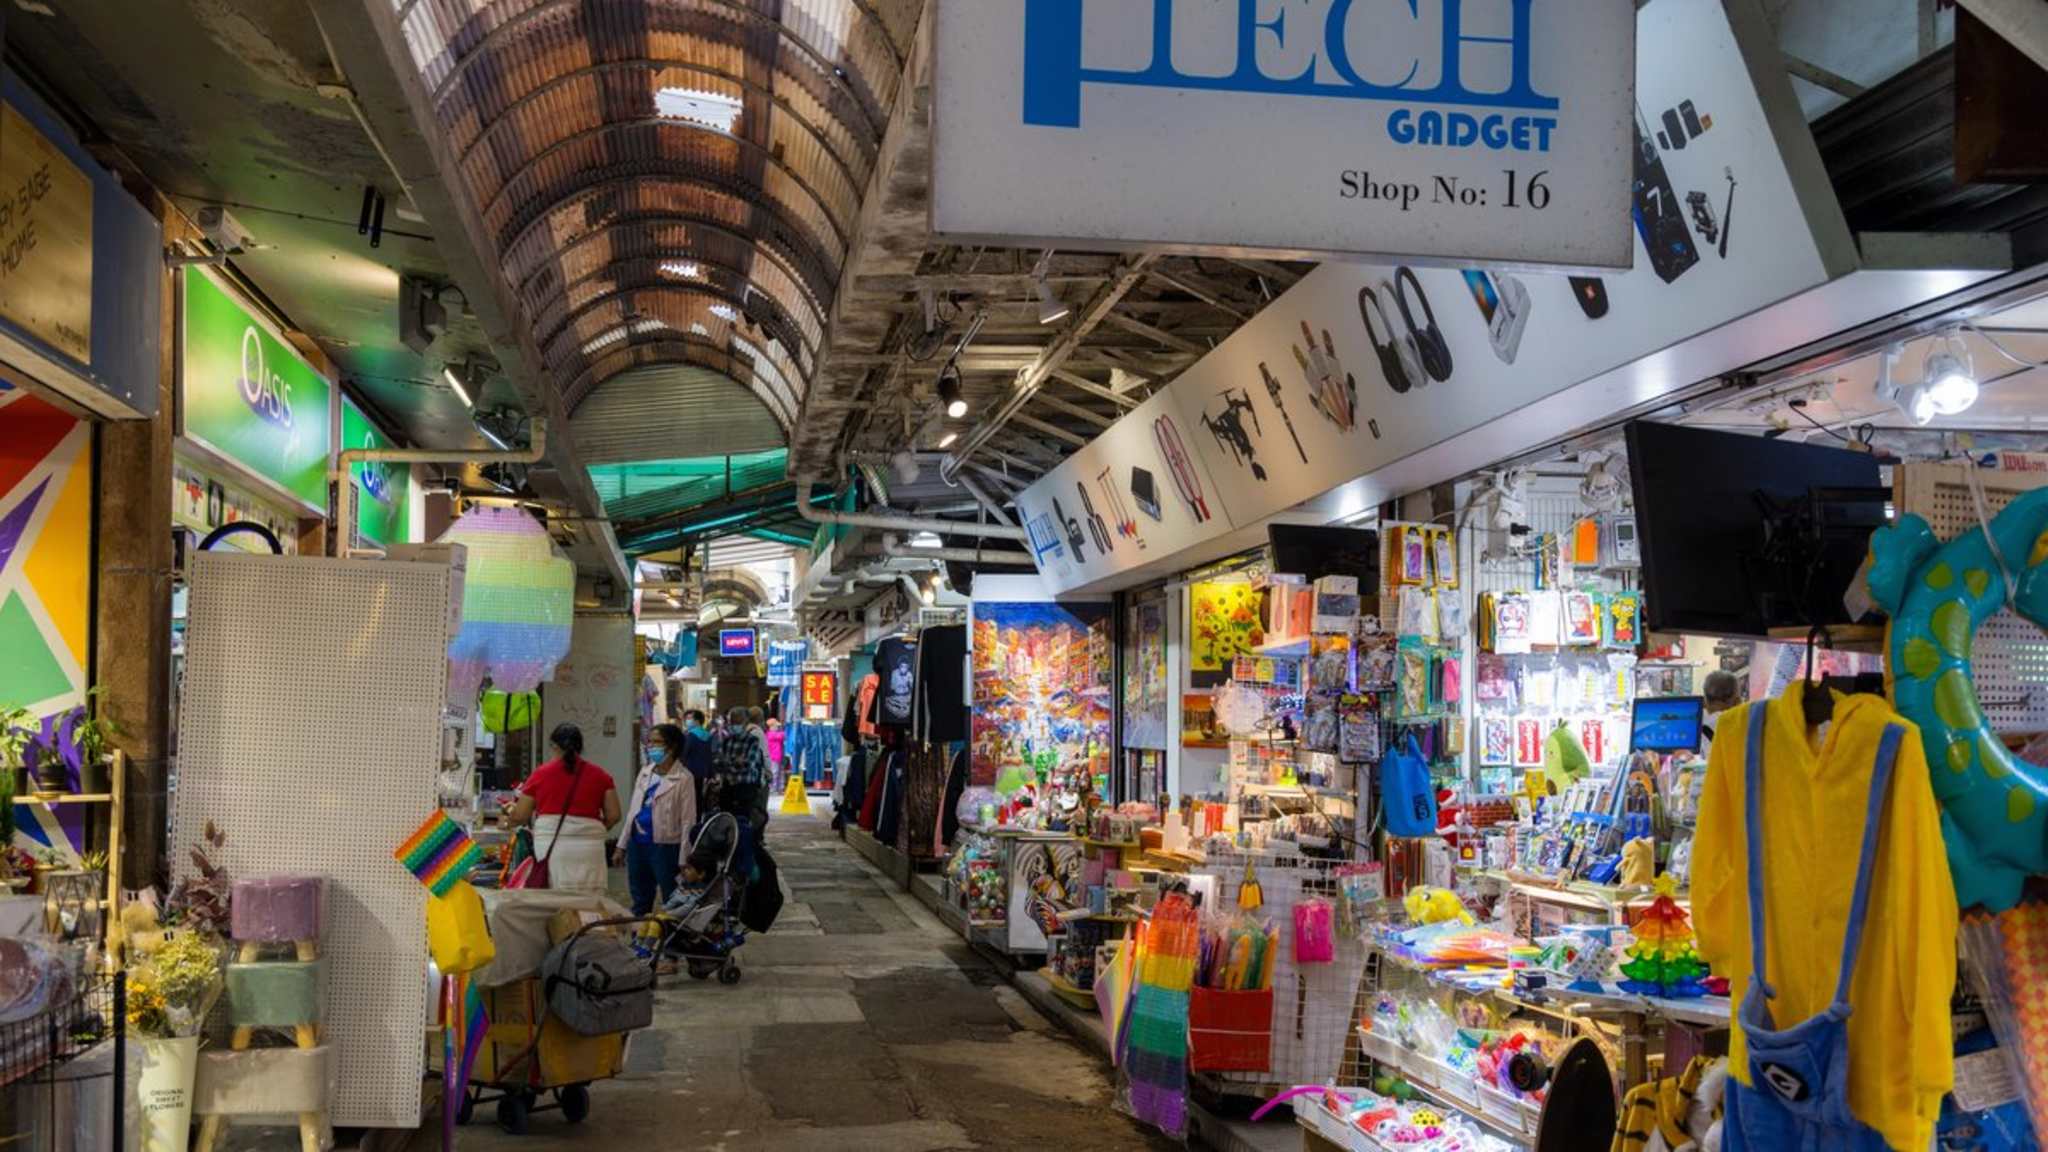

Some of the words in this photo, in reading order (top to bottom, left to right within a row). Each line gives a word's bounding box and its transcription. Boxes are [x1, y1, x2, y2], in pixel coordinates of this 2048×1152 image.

[1387, 108, 1557, 152] GADGET
[17, 163, 52, 217] SAGE
[1340, 169, 1420, 211] Shop
[1432, 175, 1487, 206] No:
[1501, 169, 1550, 210] 16
[0, 220, 37, 278] HOME
